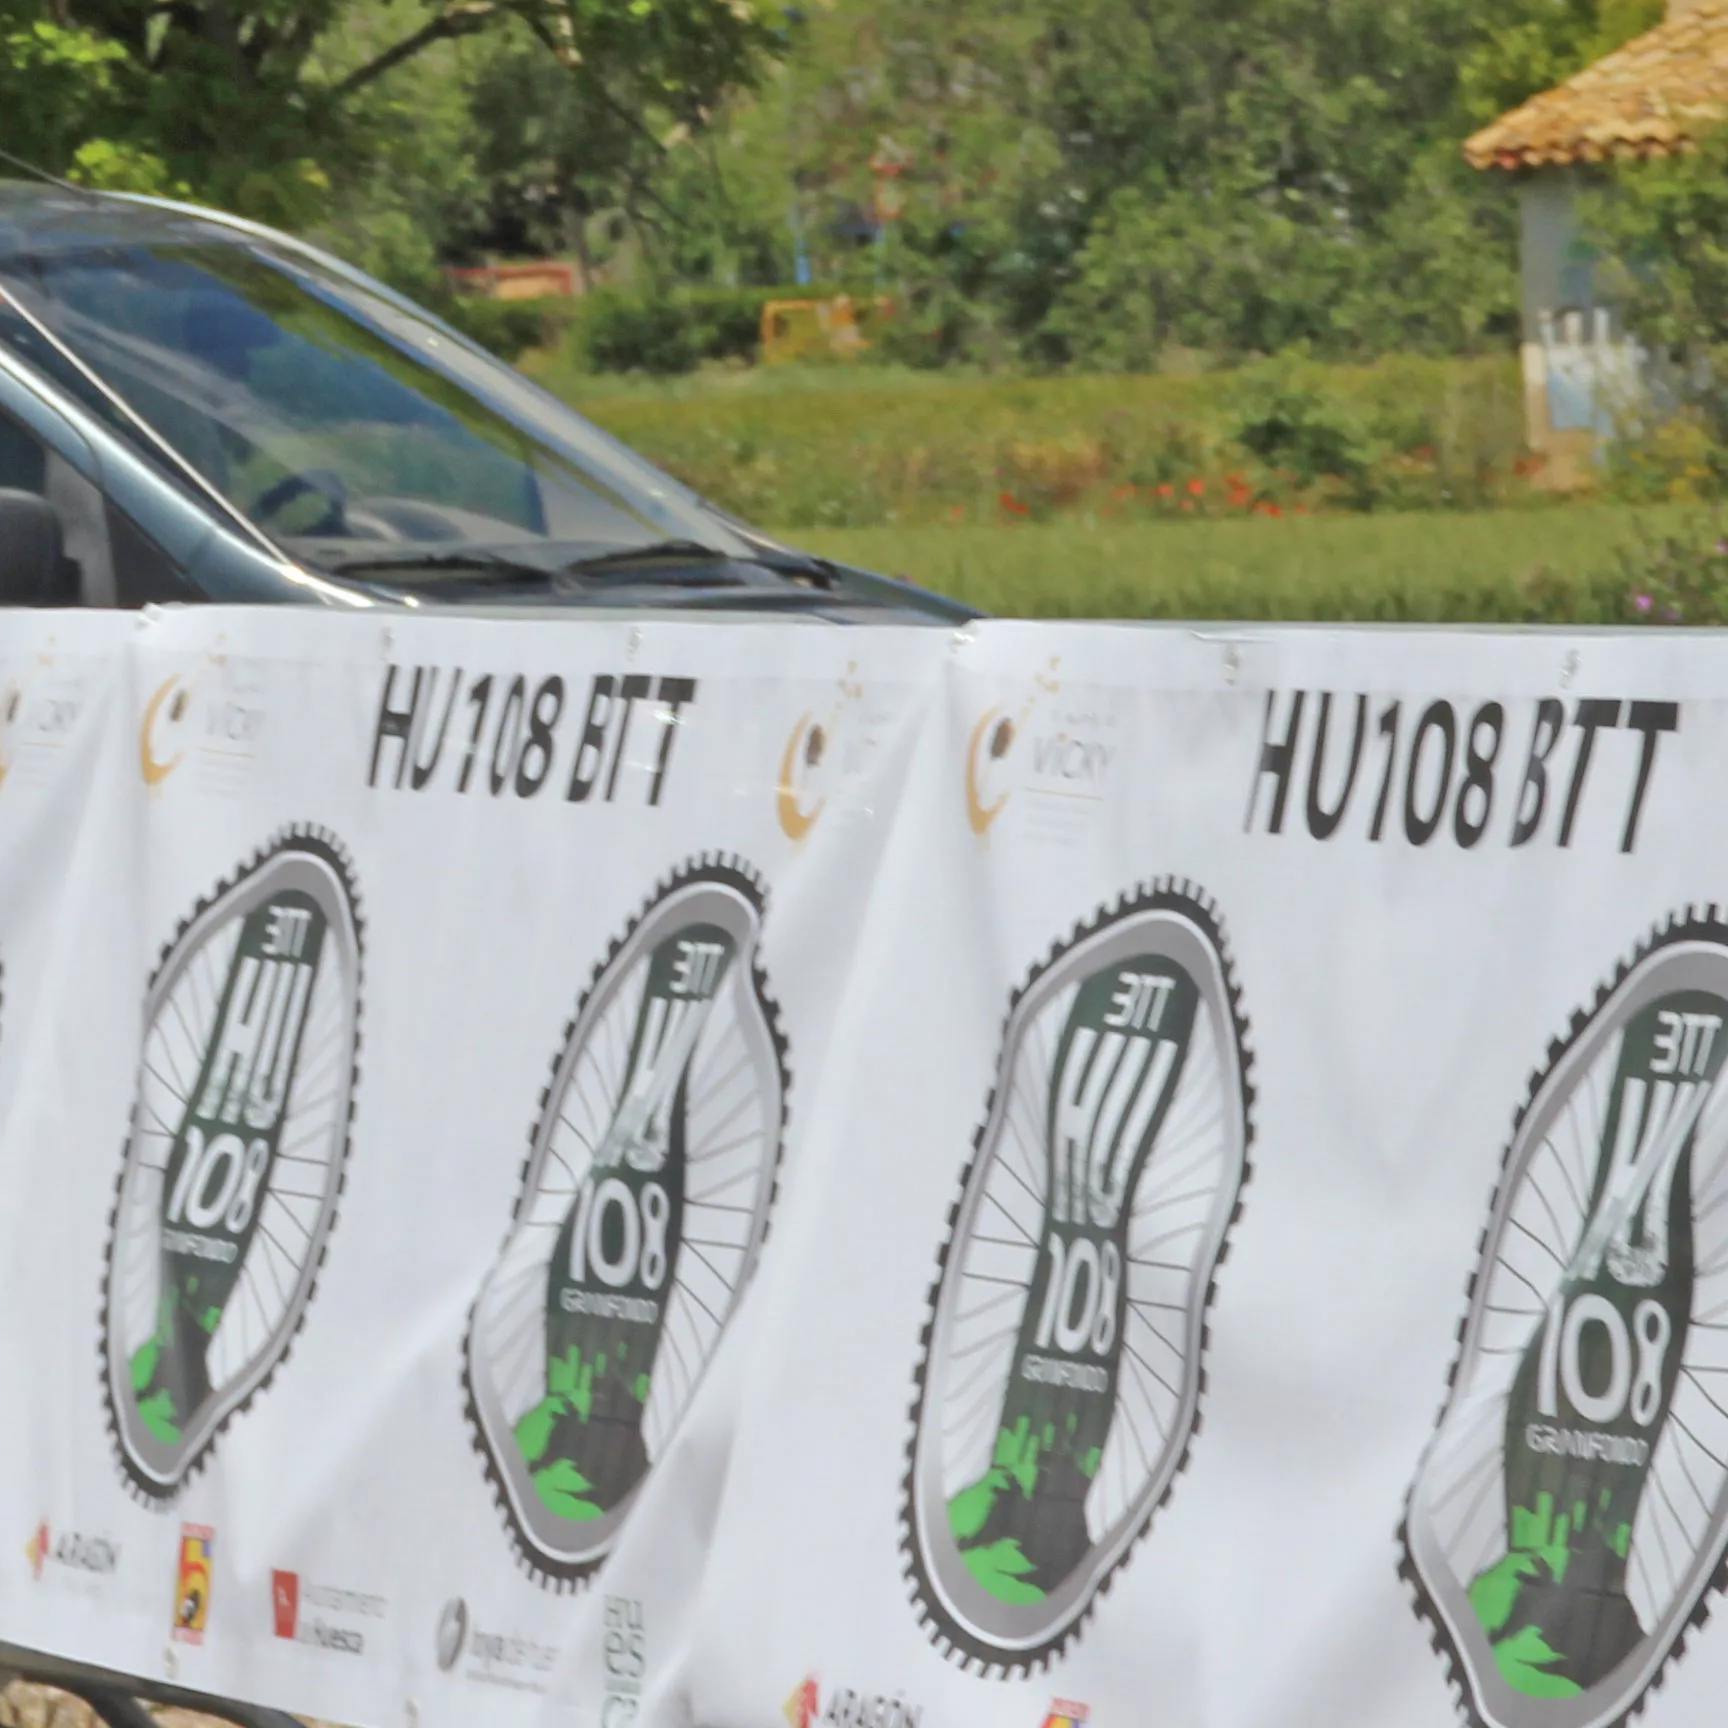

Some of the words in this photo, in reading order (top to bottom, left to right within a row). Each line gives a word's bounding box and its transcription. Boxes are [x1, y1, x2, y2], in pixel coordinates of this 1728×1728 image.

[367, 664, 566, 799] HU108
[566, 674, 700, 806] BTT
[1244, 688, 1506, 850] HU108
[1508, 697, 1680, 854] BTT
[1032, 1230, 1122, 1358] 108
[1536, 1290, 1672, 1428] 108
